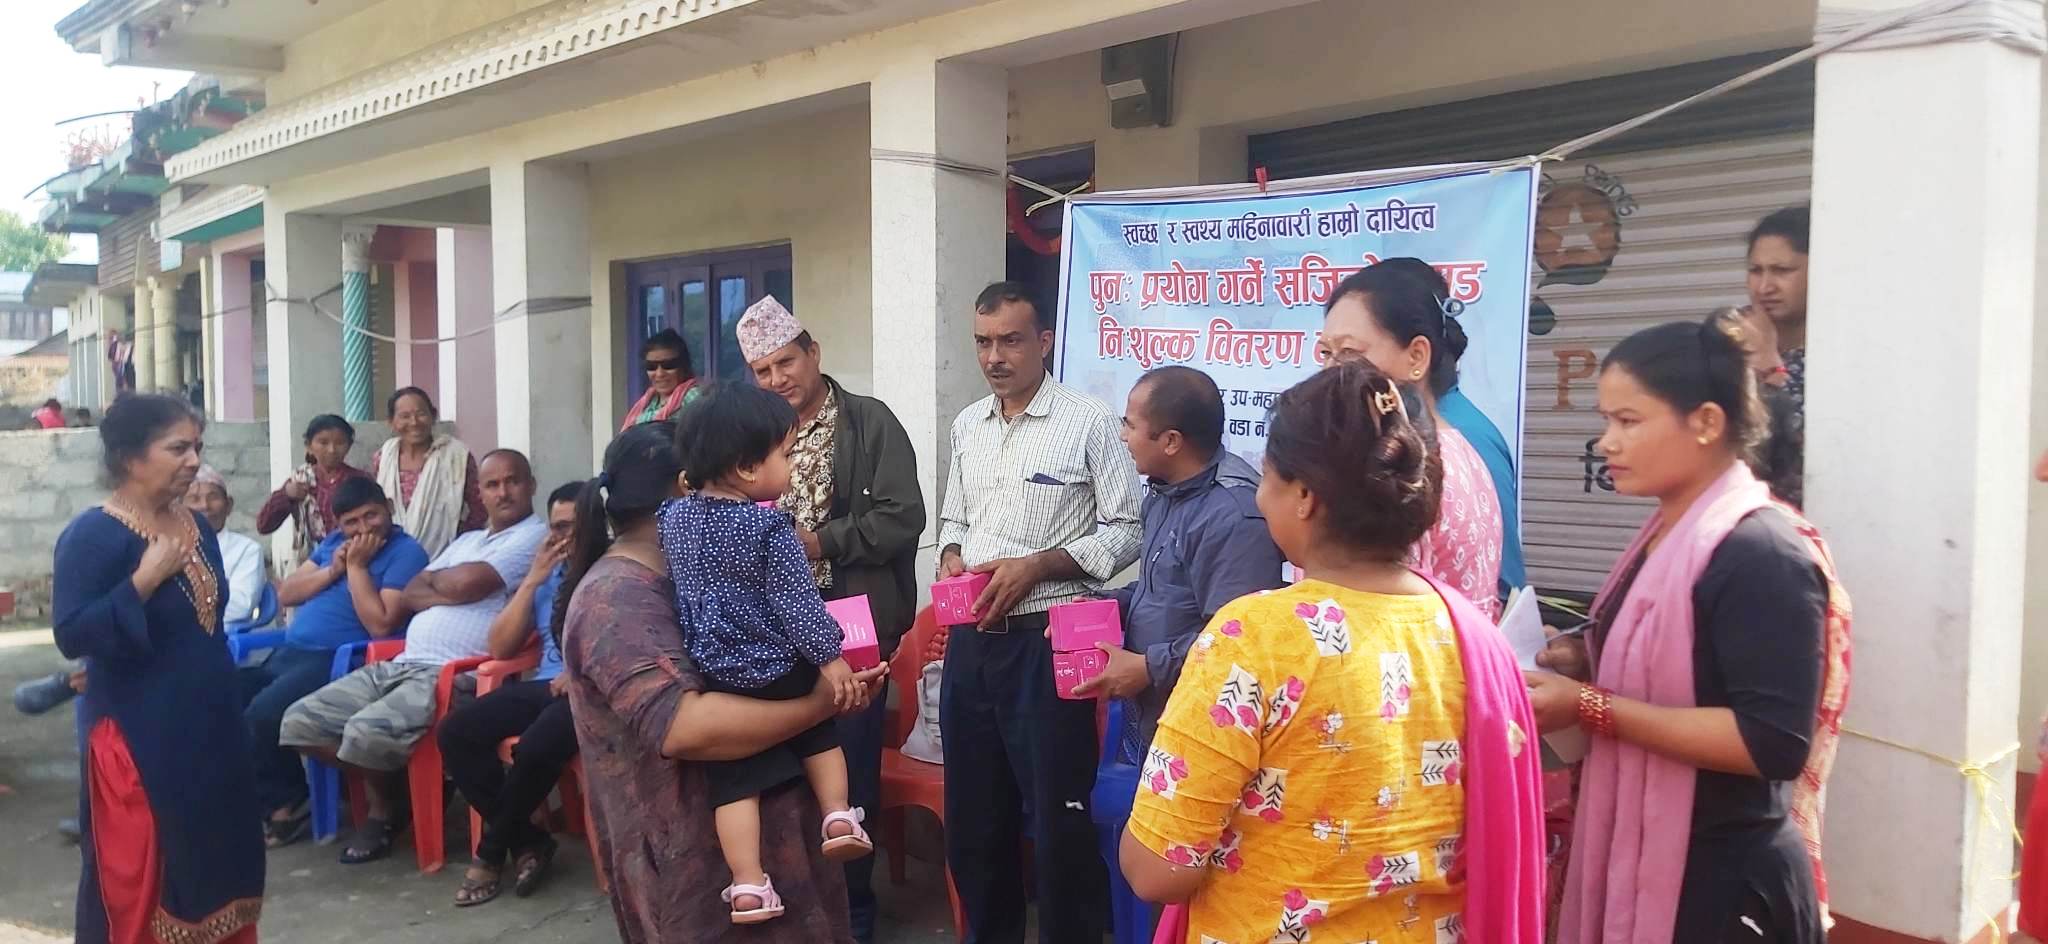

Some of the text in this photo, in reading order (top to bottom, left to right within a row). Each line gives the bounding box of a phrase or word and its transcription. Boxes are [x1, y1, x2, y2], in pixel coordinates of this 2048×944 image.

[1167, 222, 1178, 244] र
[1227, 207, 1312, 241] महिनावारी
[1317, 203, 1360, 237] हाम्रो
[1366, 199, 1436, 233] दायित्व
[1141, 261, 1209, 309] प्रयोग
[1216, 258, 1266, 304] गर्ने
[1204, 318, 1306, 367] वितरण
[1229, 418, 1252, 437] वडा
